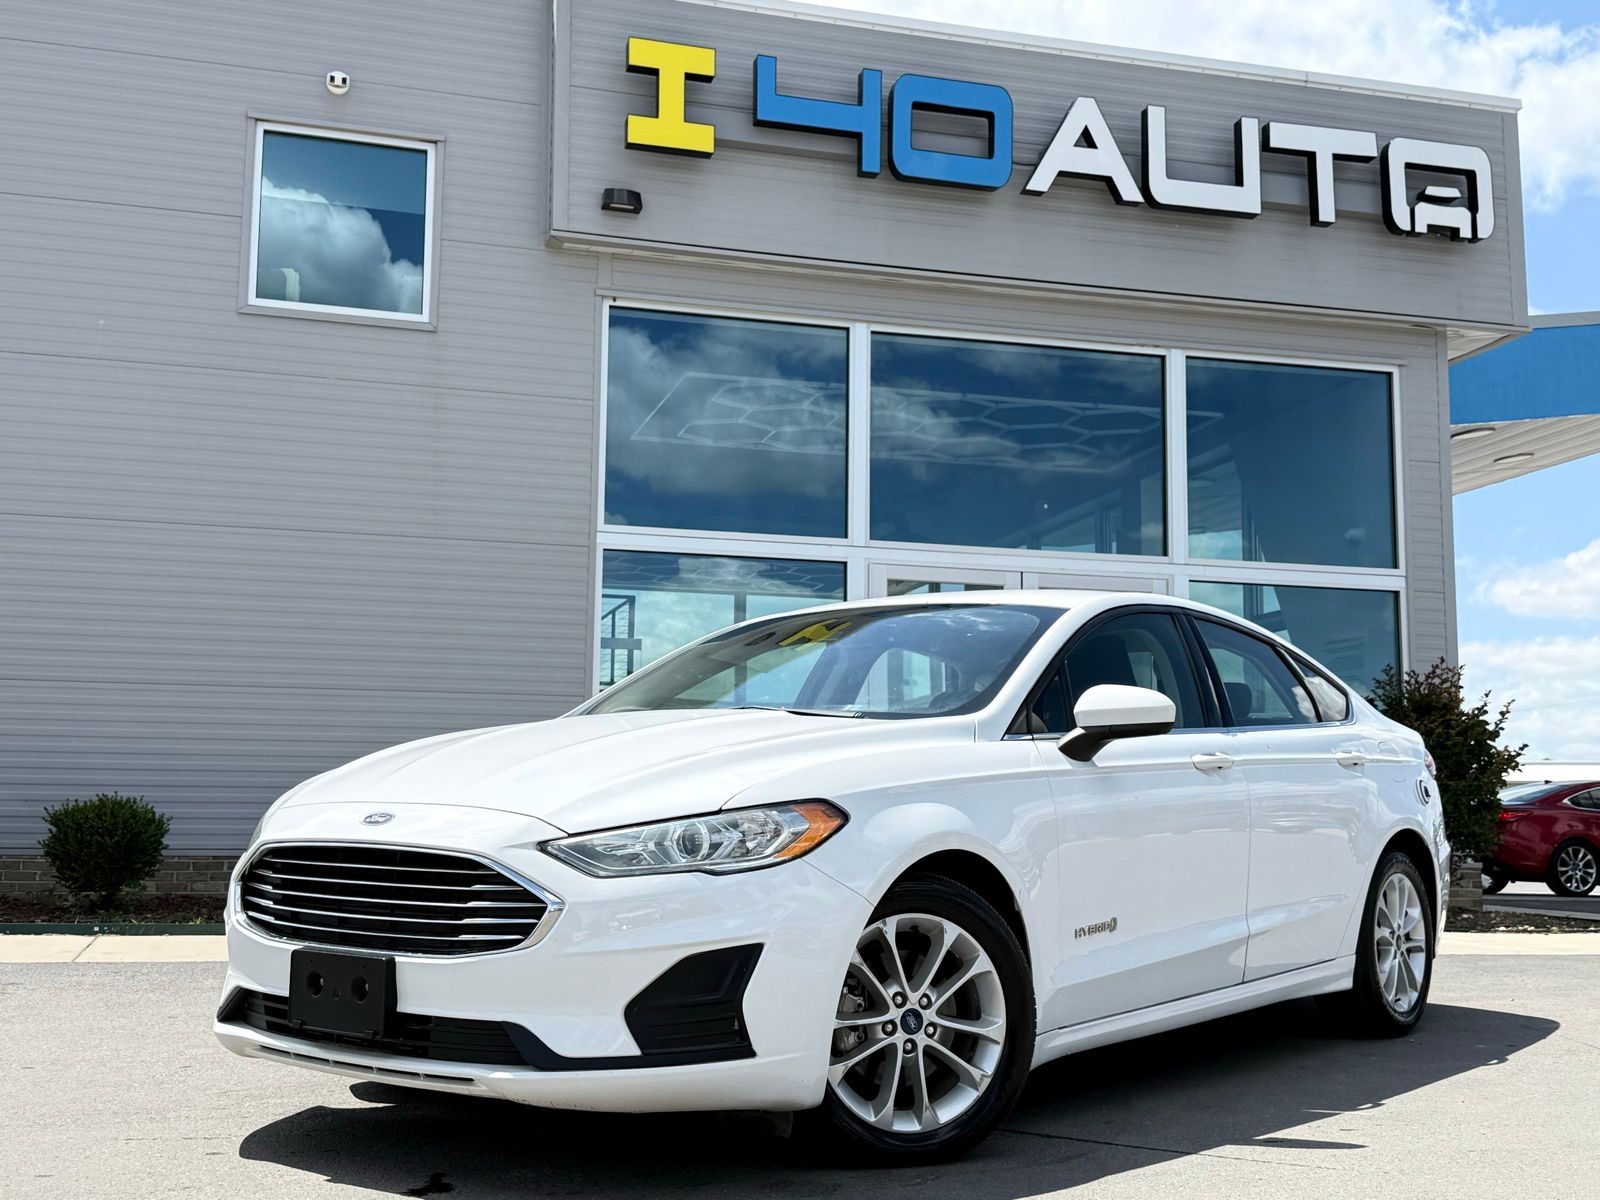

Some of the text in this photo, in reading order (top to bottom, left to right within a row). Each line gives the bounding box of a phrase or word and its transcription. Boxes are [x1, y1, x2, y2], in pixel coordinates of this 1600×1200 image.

[625, 36, 1495, 243] I 40 AUTO
[1074, 920, 1111, 939] HYBRID
